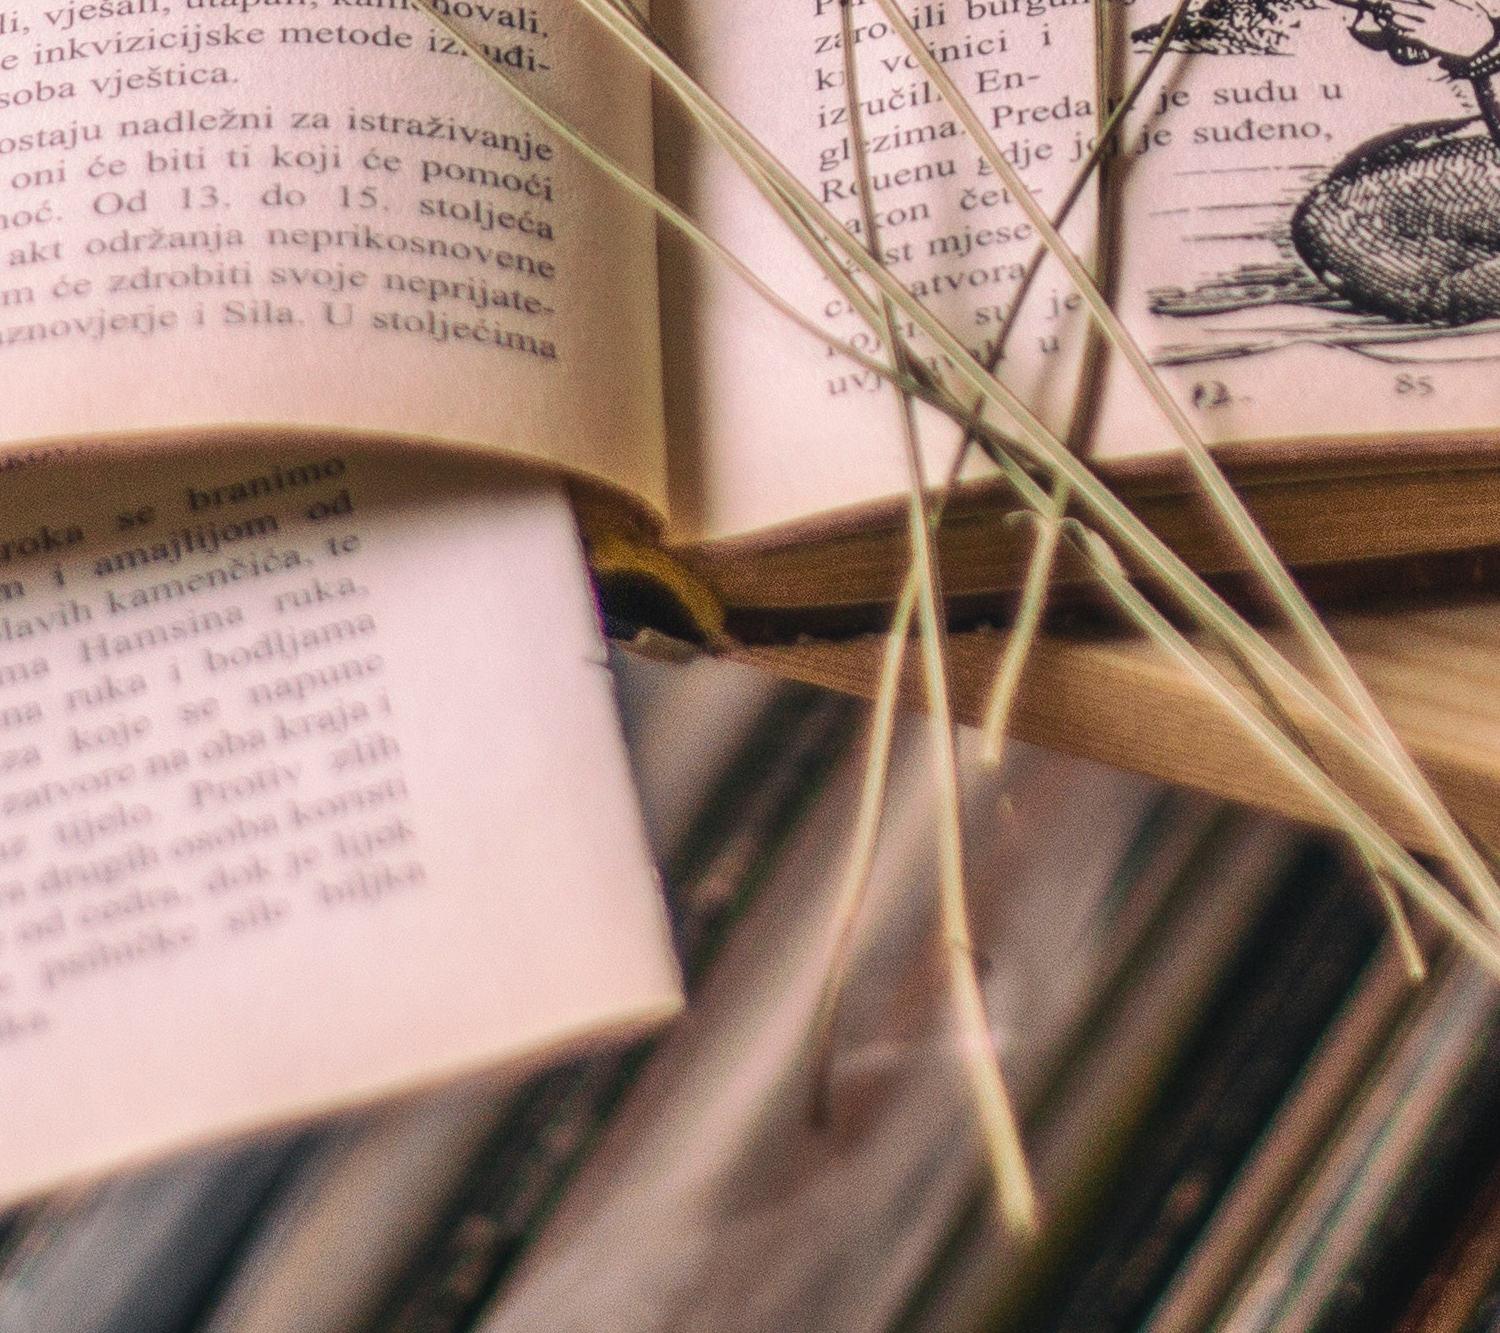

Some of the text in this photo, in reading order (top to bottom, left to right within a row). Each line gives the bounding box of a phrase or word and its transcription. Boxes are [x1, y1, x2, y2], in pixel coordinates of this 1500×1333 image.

[34, 23, 265, 65] inkvizicijske
[280, 23, 413, 50] metode
[90, 64, 239, 97] vještica.
[976, 69, 1042, 95] En-
[1214, 79, 1299, 106] sudu
[119, 105, 273, 138] nadležni
[348, 108, 553, 164] istraživanje
[1192, 116, 1334, 145] suđeno,
[421, 158, 554, 203] pomoći
[180, 185, 554, 240] 13. 15. stoljeća
[267, 226, 557, 282] neprikosnovene
